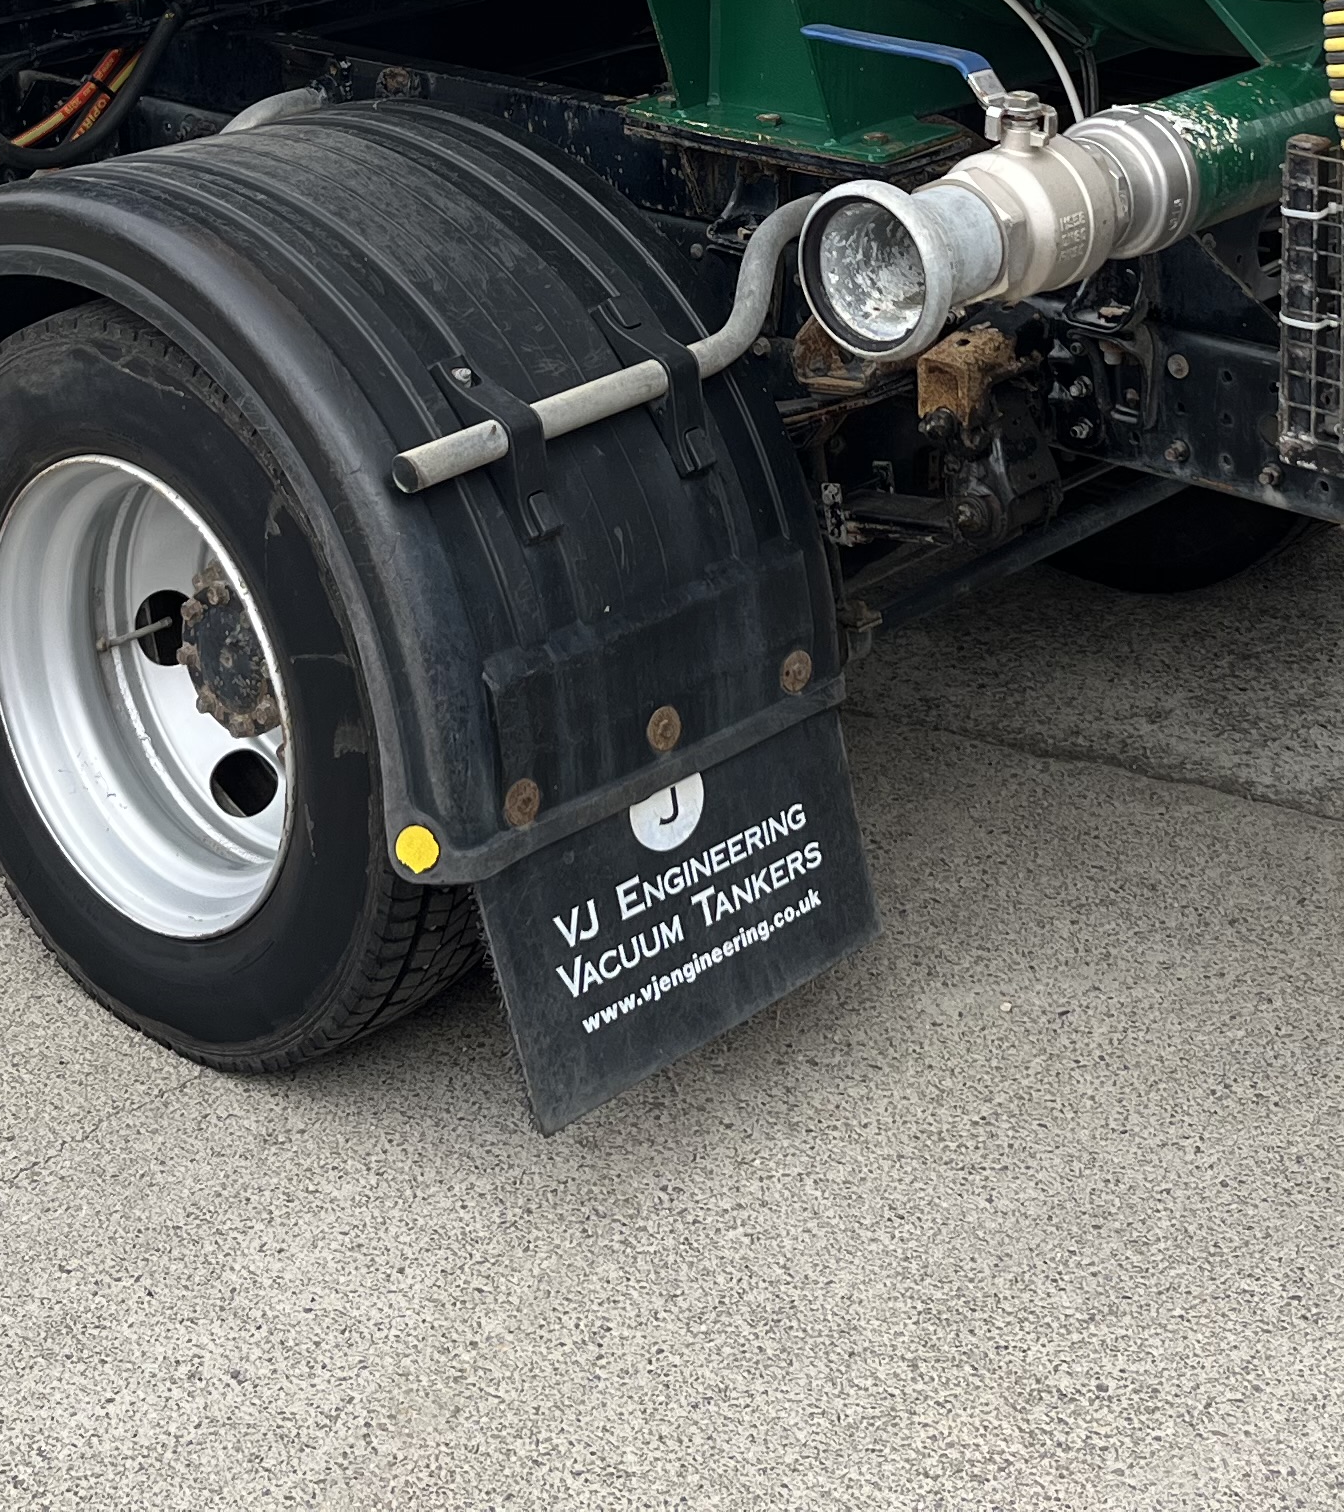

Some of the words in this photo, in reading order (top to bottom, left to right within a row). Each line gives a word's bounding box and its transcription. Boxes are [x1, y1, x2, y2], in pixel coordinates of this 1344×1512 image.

[553, 898, 600, 948] VJ
[616, 803, 807, 920] ENGINEERING
[556, 915, 685, 998] VACUUM
[691, 842, 823, 927] TANKERS
[582, 887, 822, 1034] www.vjengineering.co.uk
